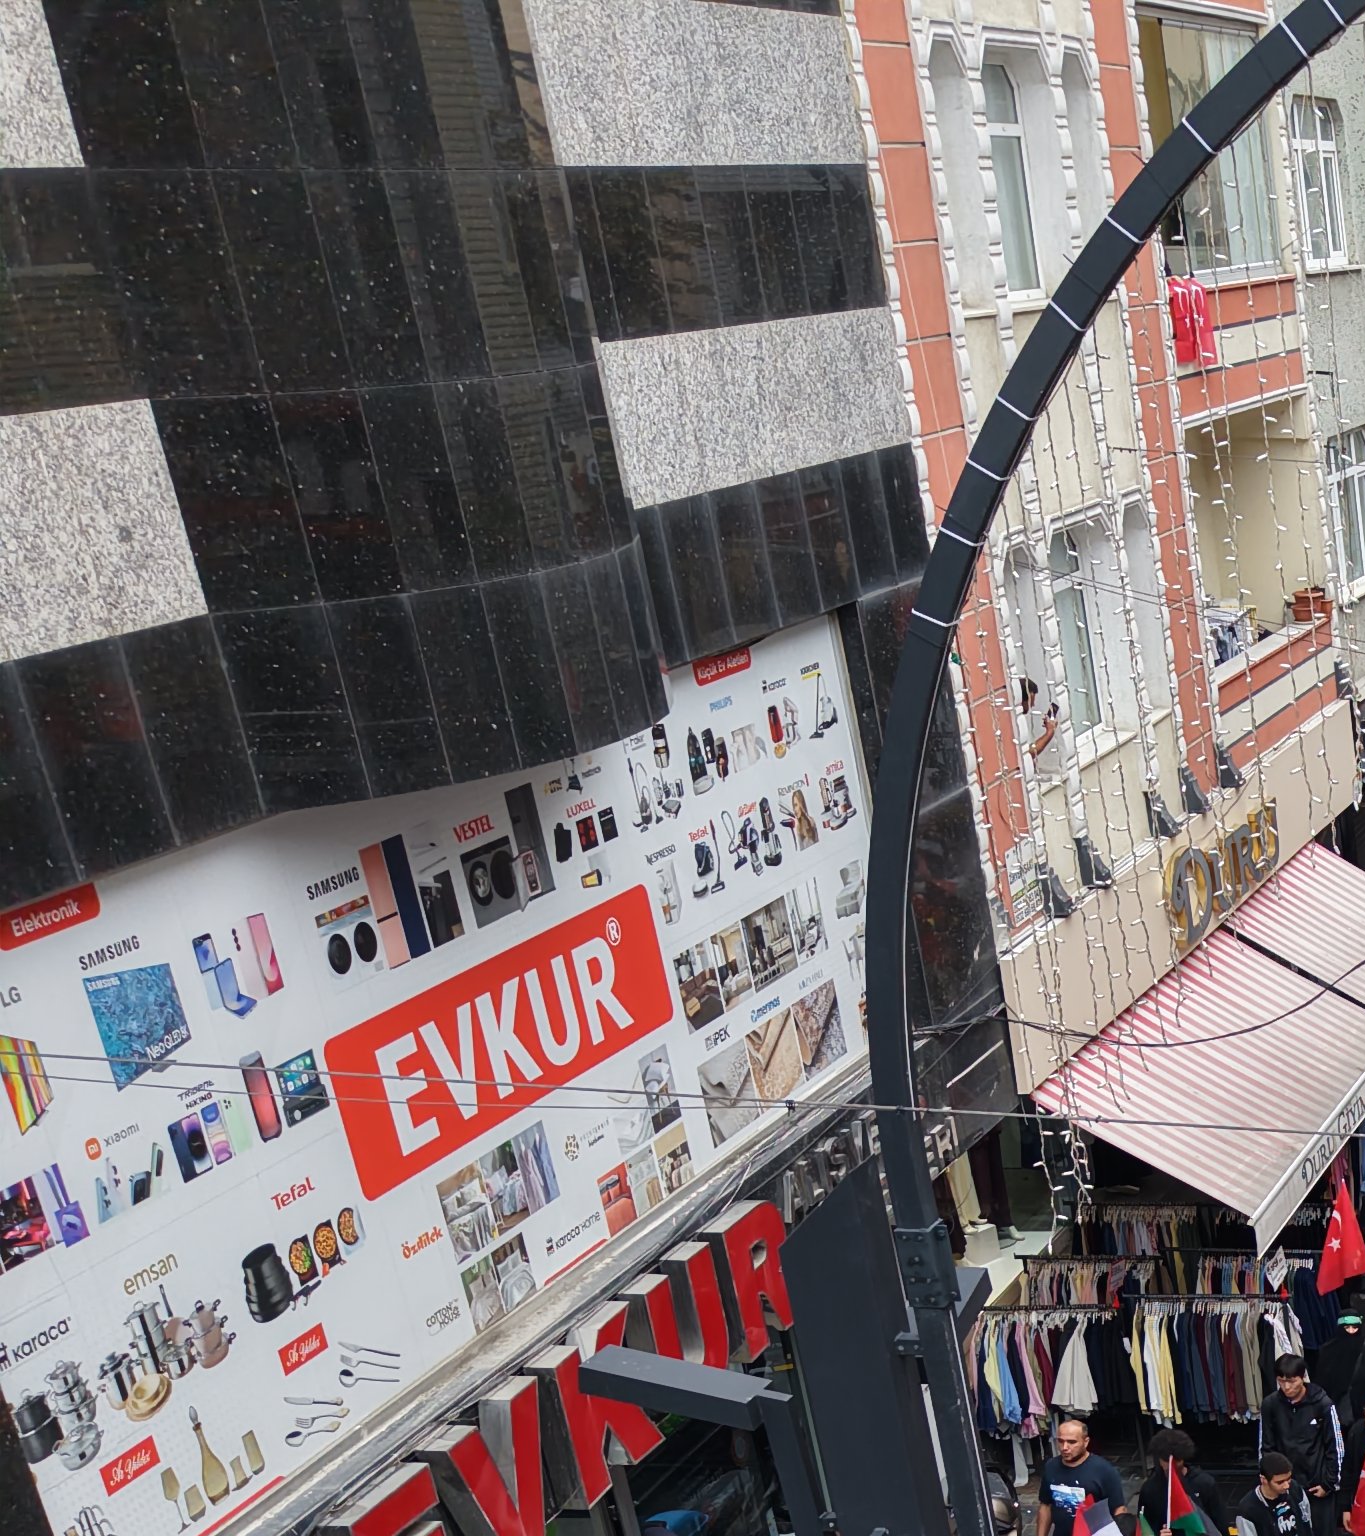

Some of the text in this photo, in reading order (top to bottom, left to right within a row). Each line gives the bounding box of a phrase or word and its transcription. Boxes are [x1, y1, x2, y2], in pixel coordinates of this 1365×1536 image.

[565, 798, 597, 818] LUXELL
[452, 814, 495, 843] VESTEL
[688, 825, 709, 842] Tefal
[306, 866, 361, 901] SAMSUNG
[10, 899, 81, 938] Elektronik
[78, 935, 141, 971] SAMSUNG
[146, 1038, 166, 1062] Neo
[374, 941, 639, 1157] EVKUR
[271, 1177, 315, 1211] Tefal
[401, 1226, 444, 1260] Özdilek
[123, 1253, 179, 1296] emsan
[11, 1318, 70, 1358] karaca
